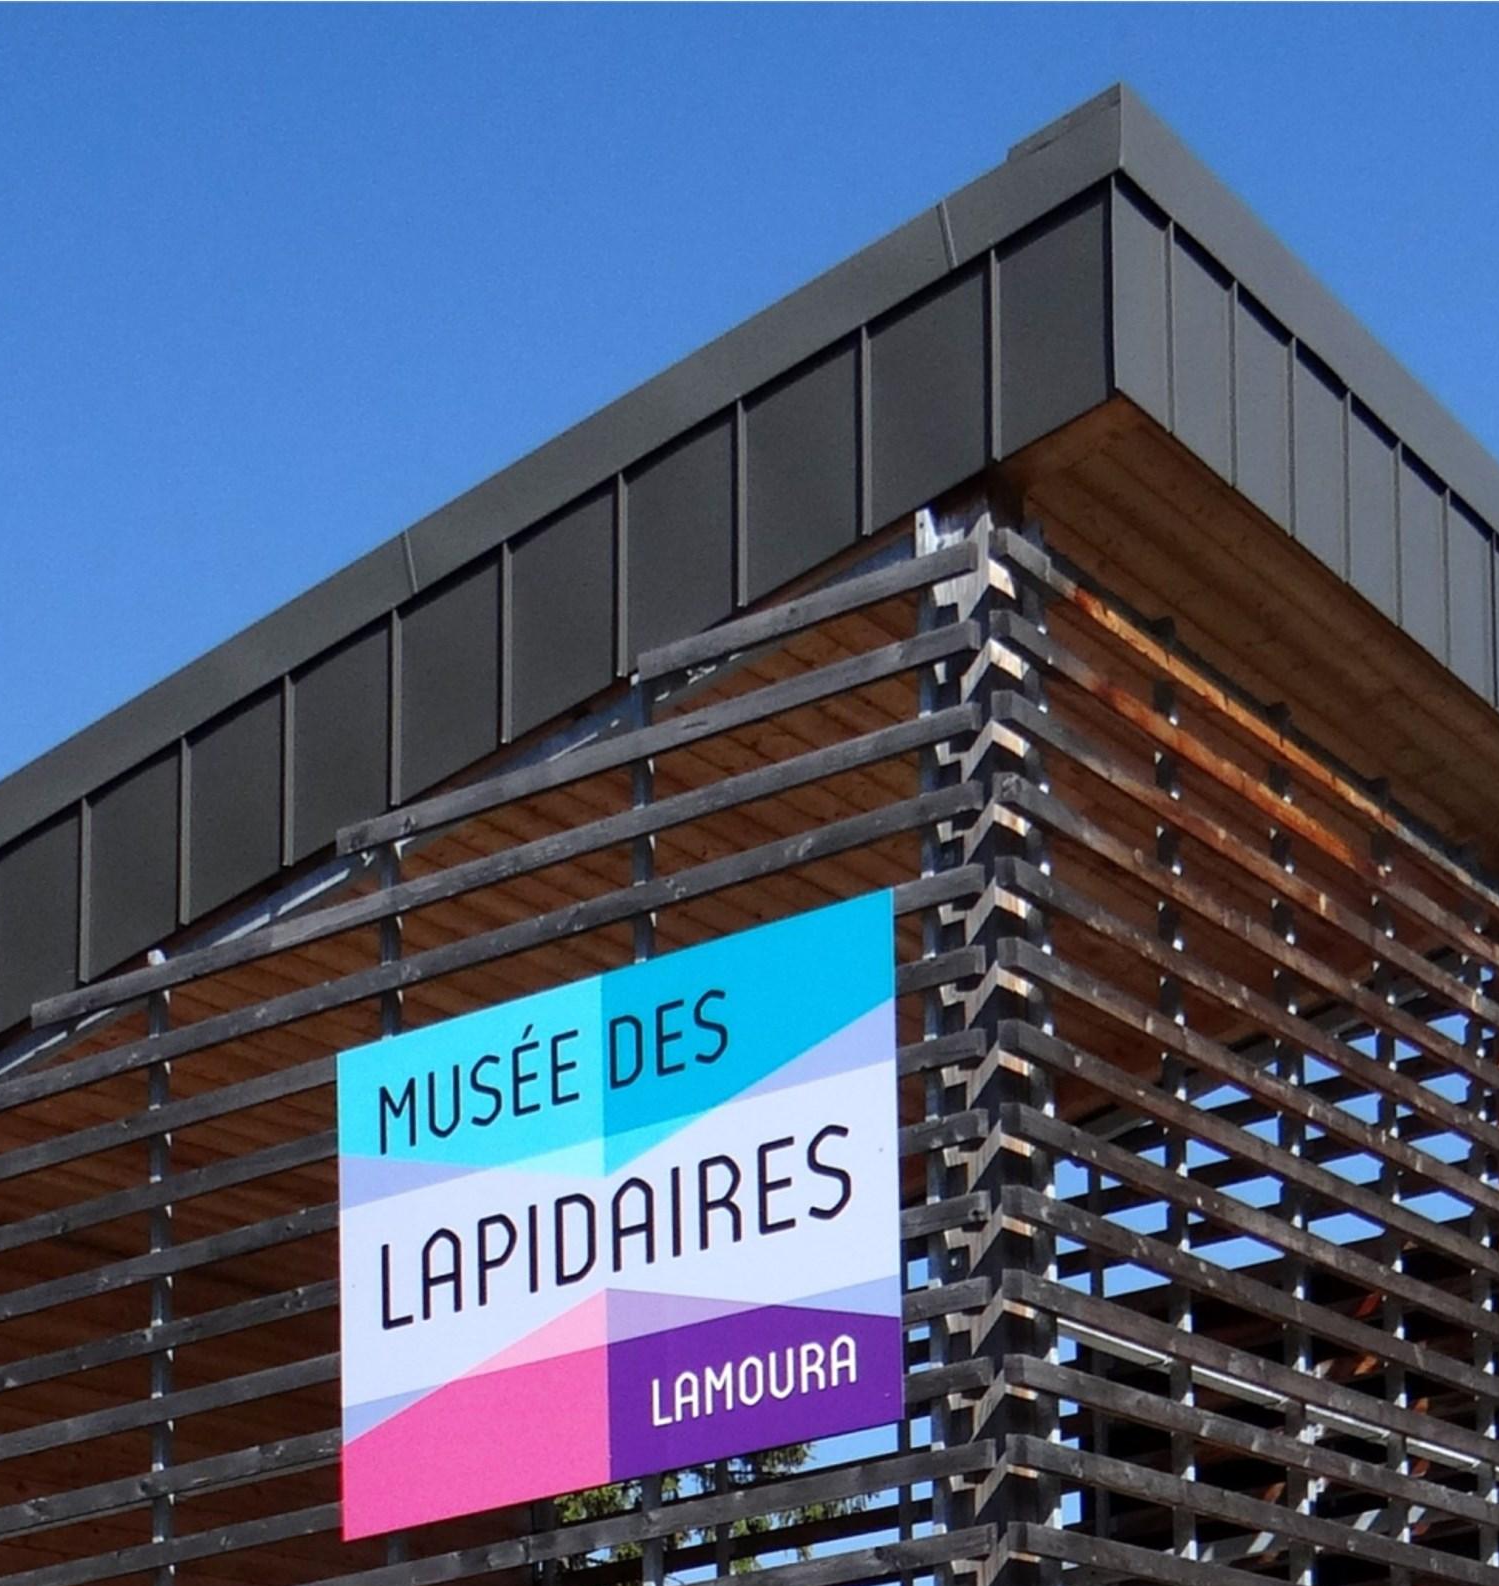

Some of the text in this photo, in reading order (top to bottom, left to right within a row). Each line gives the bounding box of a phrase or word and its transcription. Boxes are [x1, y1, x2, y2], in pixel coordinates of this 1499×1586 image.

[378, 988, 729, 1156] MUSÉE DES
[380, 1123, 853, 1332] LAPIDAIRES
[651, 1333, 858, 1427] LAMOURA
